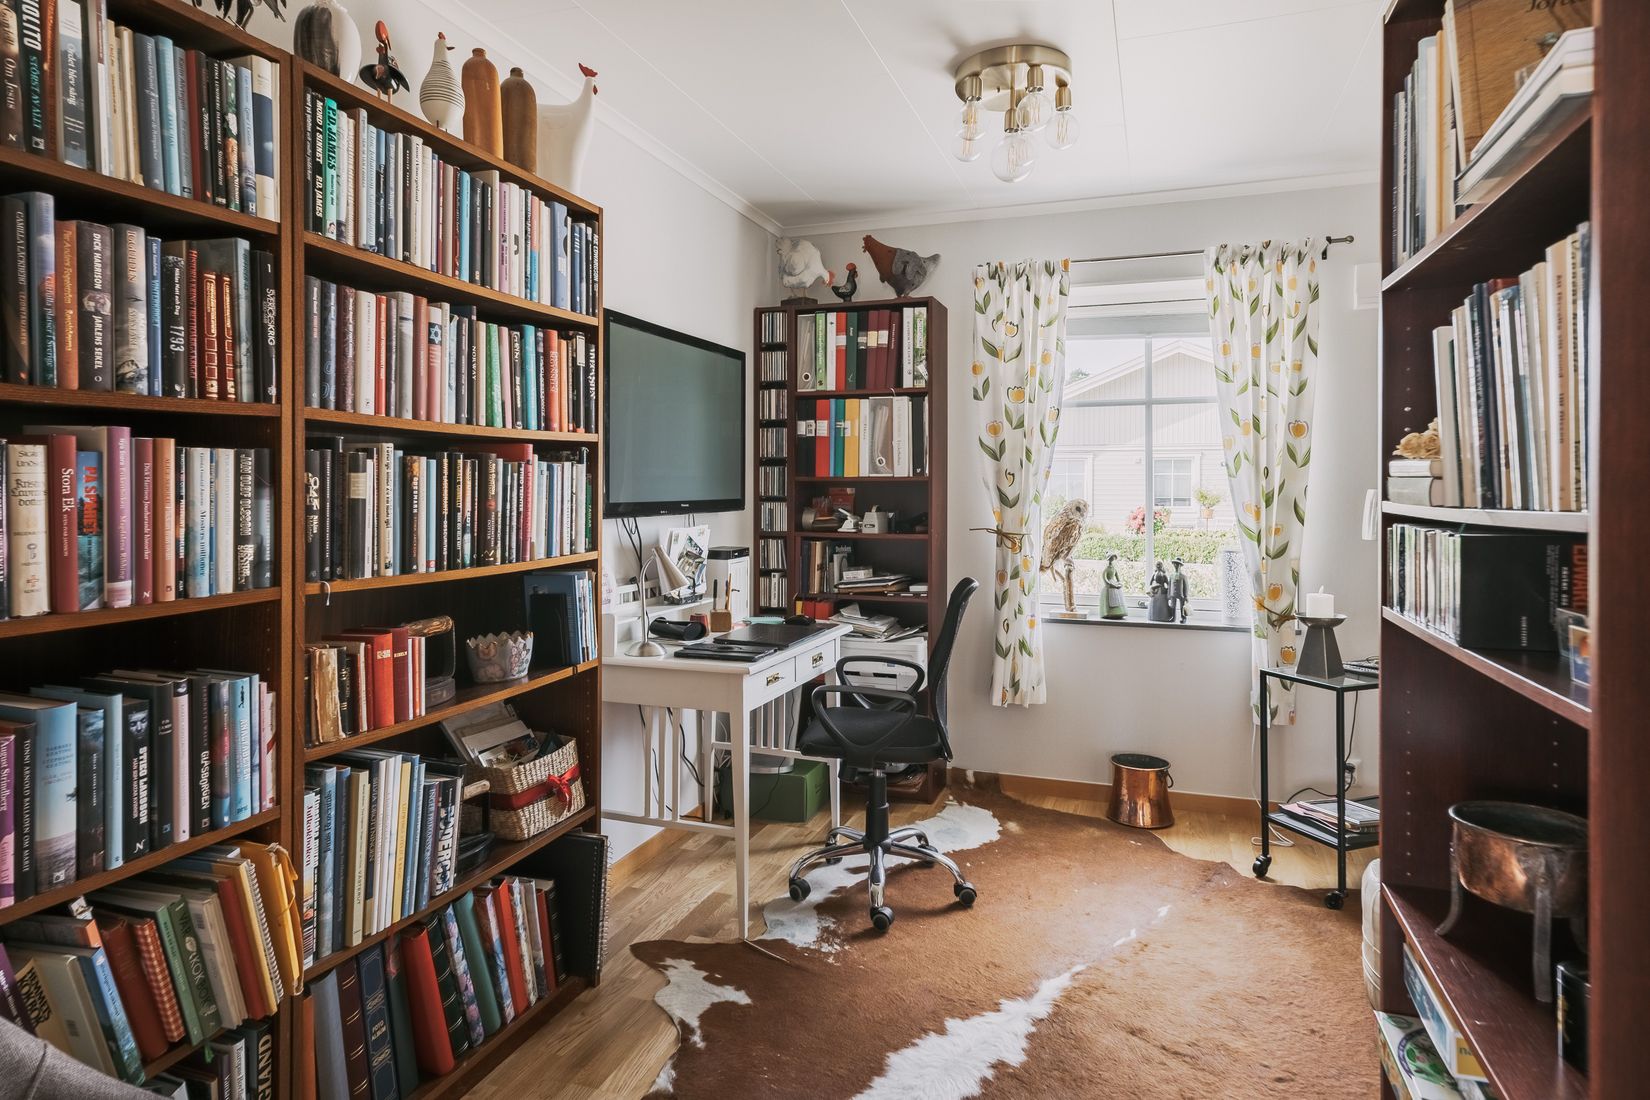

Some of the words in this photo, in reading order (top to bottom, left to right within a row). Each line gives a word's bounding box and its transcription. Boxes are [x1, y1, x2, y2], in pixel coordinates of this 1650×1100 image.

[4, 57, 17, 78] Om
[67, 43, 77, 67] Ordet
[67, 69, 78, 85] blev
[4, 80, 18, 109] Jesus
[67, 87, 78, 106] sång
[315, 99, 323, 125] MORD
[315, 132, 323, 164] SINNET
[315, 189, 323, 218] JAMES
[93, 233, 102, 251] DICK
[93, 252, 102, 289] HARRISON
[92, 316, 103, 346] JARLENS
[169, 325, 185, 352] 1793
[45, 340, 56, 367] Sverige
[92, 347, 103, 369] SEKEL
[61, 467, 74, 495] Stora
[142, 462, 151, 476] Dick
[61, 497, 75, 512] Ek
[0, 740, 10, 768] August
[139, 745, 148, 777] STIEG
[0, 769, 11, 812] Strindberg
[22, 765, 31, 796] ARNOLD
[199, 750, 211, 810] GLASBORGEN
[139, 777, 148, 825] LARSSON
[22, 797, 31, 834] BALLADEN
[22, 835, 31, 848] OM
[305, 806, 313, 868] Julkokboken
